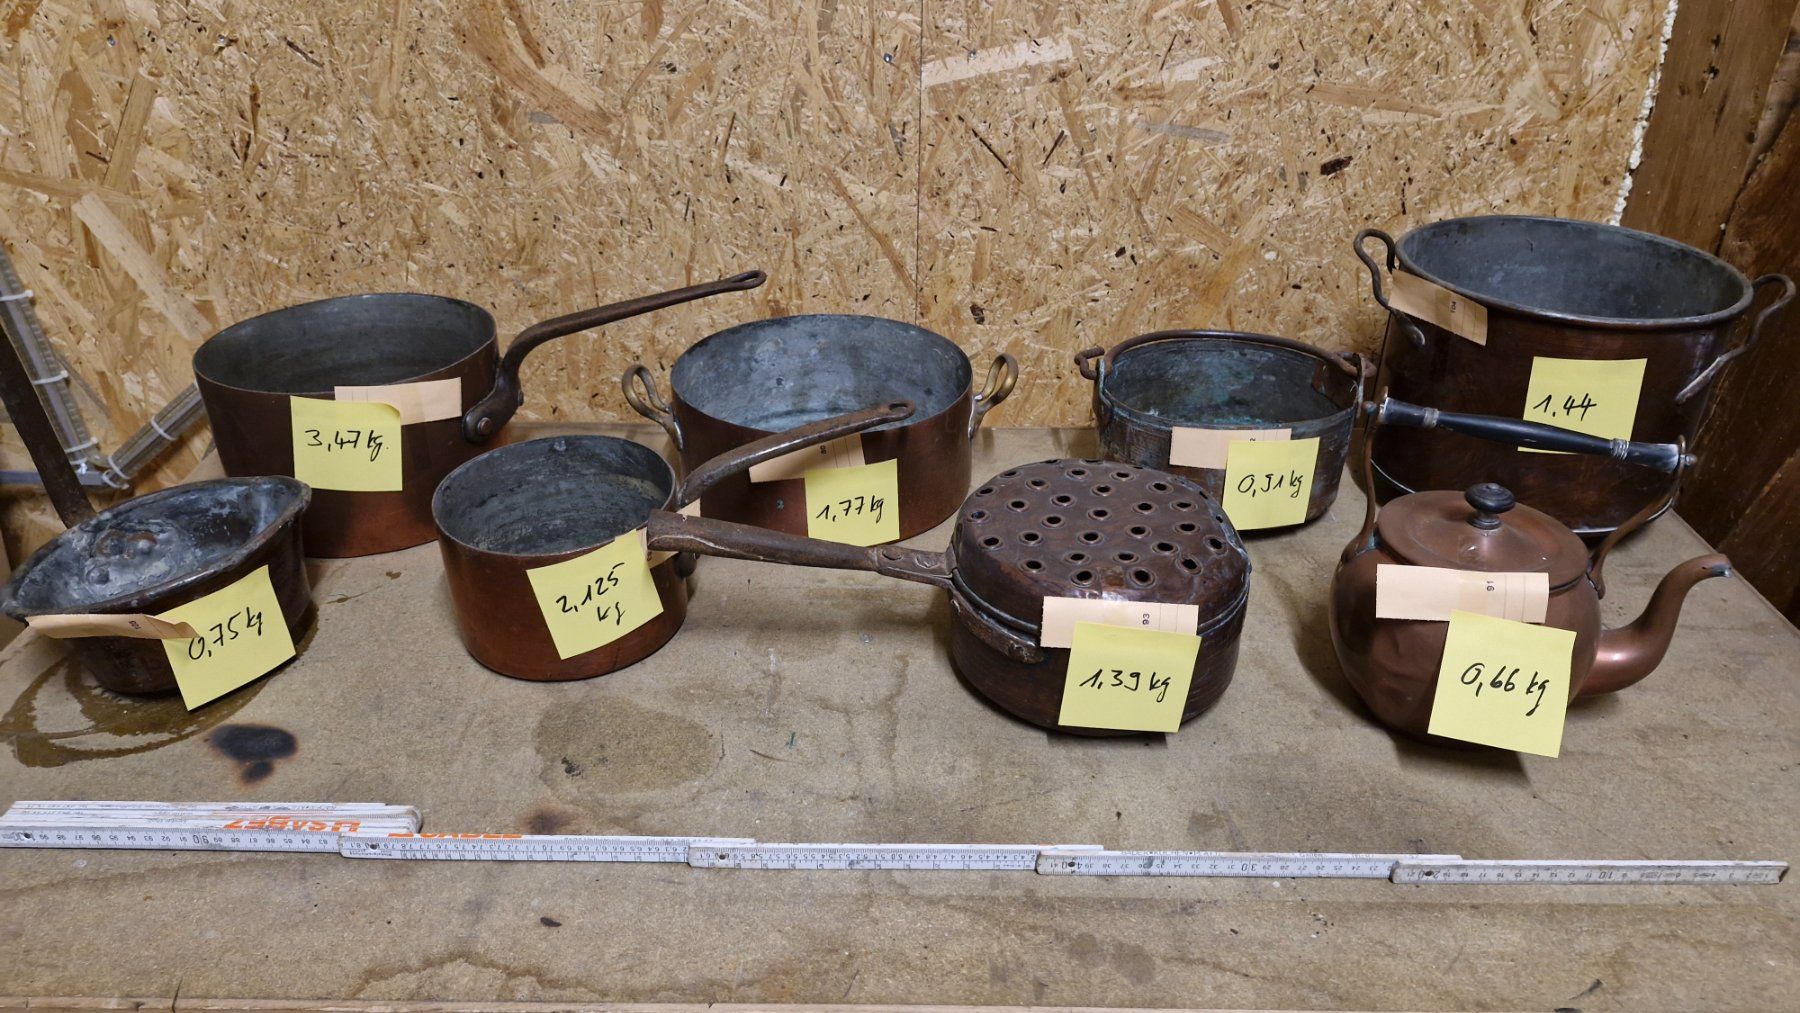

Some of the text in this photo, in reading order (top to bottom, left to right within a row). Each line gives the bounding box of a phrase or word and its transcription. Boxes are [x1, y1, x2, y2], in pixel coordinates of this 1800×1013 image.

[300, 429, 361, 452] 3,47
[1289, 470, 1304, 498] kg
[816, 495, 884, 524] 1,77 kg
[556, 562, 625, 613] 2,125
[597, 601, 626, 626] kg
[1079, 669, 1171, 703] 1,39 kg
[1460, 663, 1550, 717] 0,66 kg
